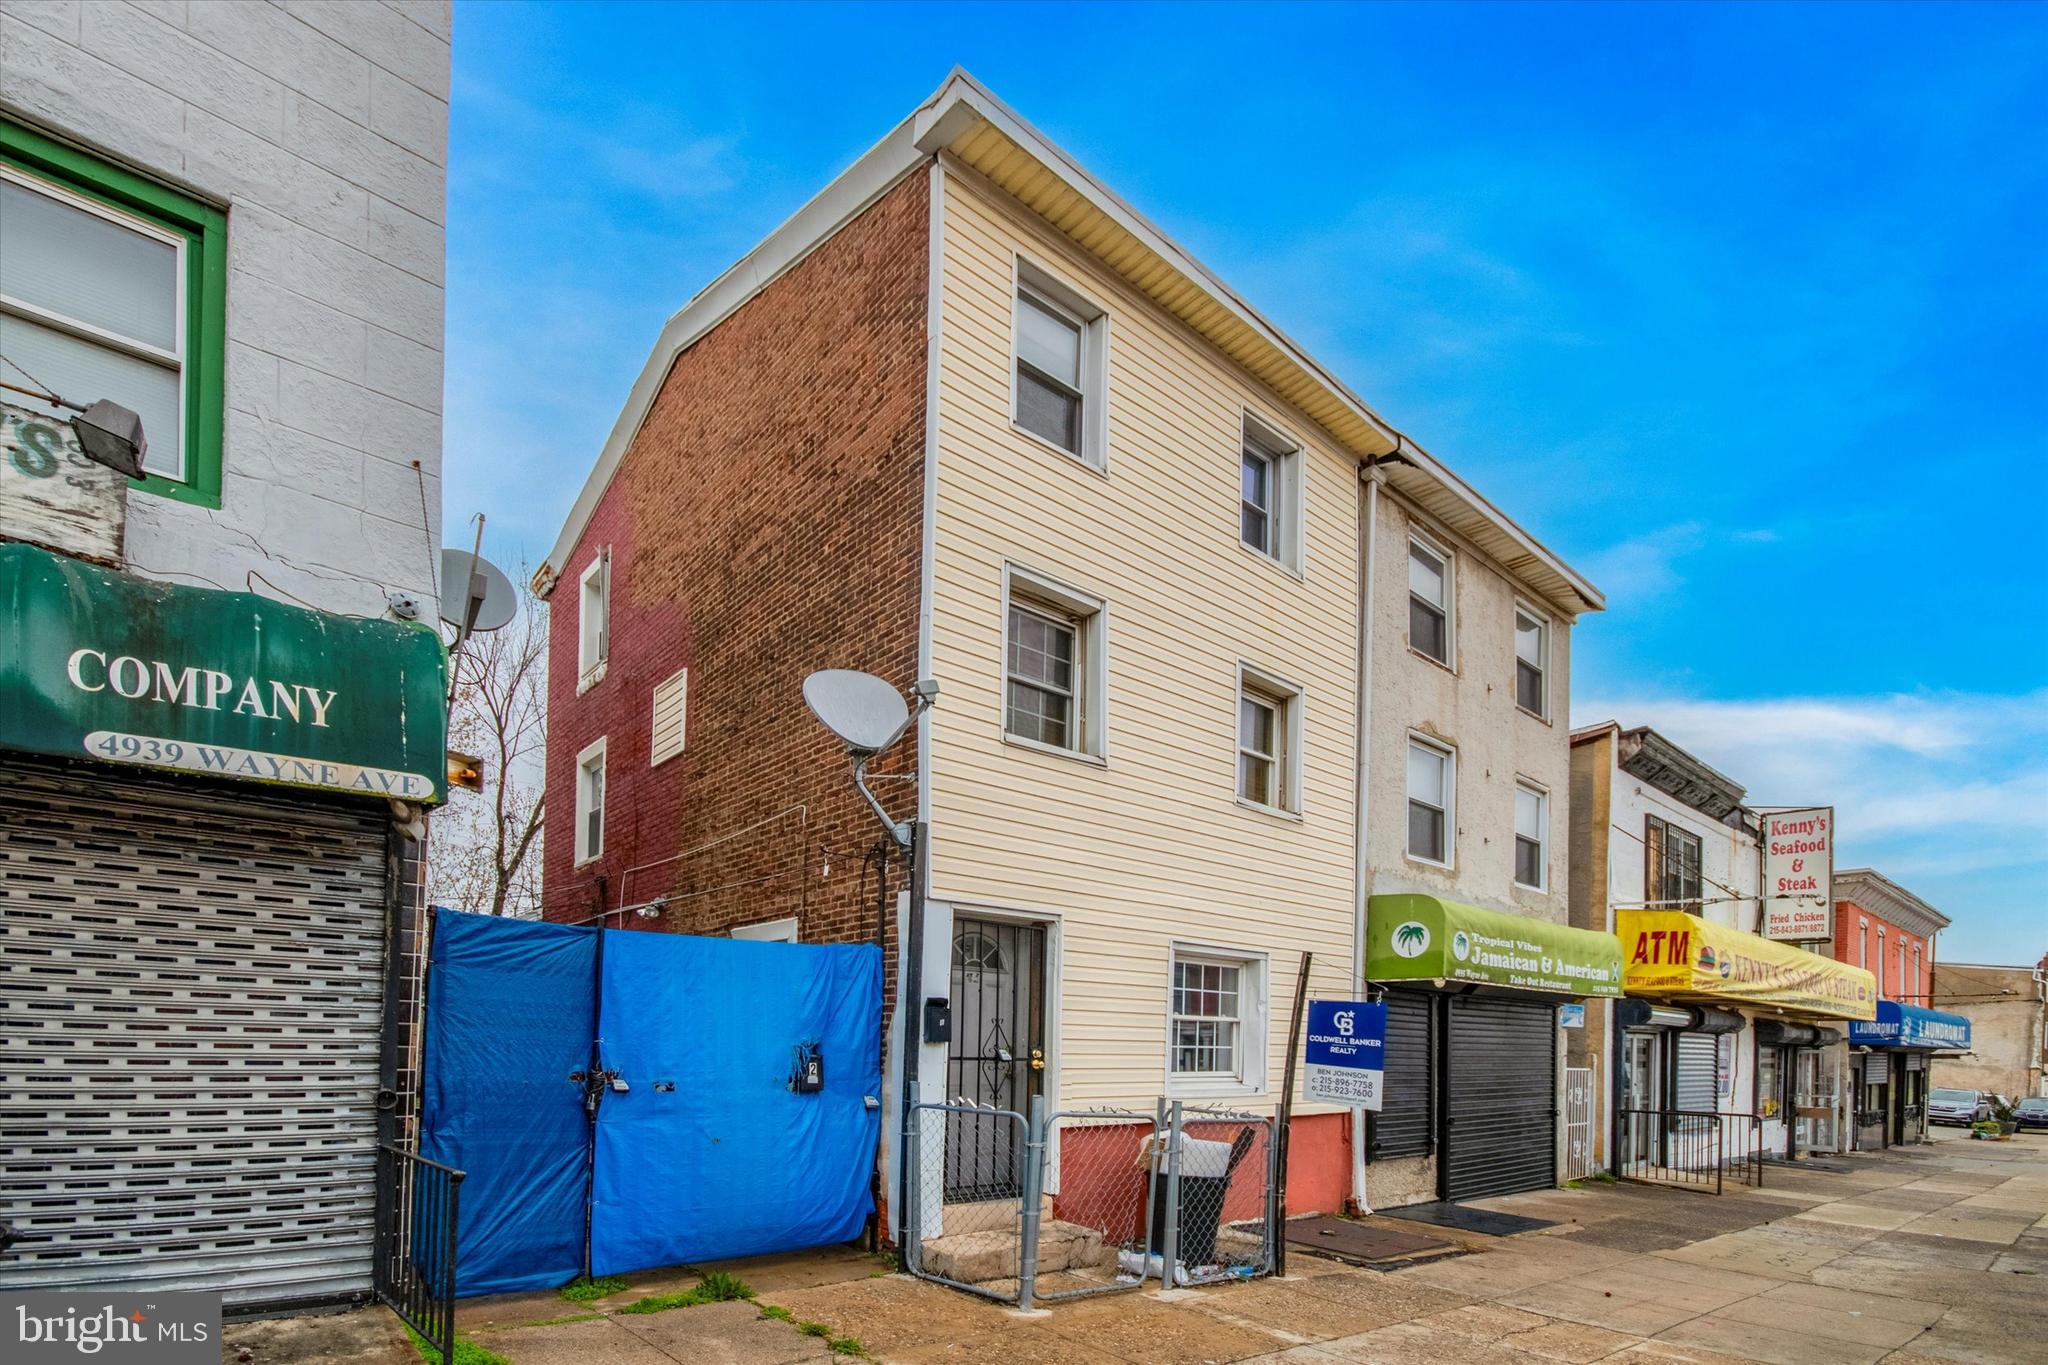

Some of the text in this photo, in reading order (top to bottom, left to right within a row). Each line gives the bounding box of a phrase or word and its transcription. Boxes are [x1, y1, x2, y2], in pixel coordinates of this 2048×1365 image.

[68, 649, 337, 727] COMPANY
[98, 734, 421, 796] 4939 WAYNE AVE
[1771, 816, 1826, 836] Kenny's
[1771, 838, 1826, 855] Seafood
[1792, 859, 1804, 873] &
[1778, 876, 1817, 891] Steak
[1770, 912, 1825, 923] Fried Chicken
[1472, 932, 1542, 953] Tropical Vibes
[1631, 931, 1690, 965] ATM
[1471, 946, 1609, 981] Jamaican & American
[1509, 974, 1572, 990] Take Out Restaurant
[1855, 1022, 1900, 1035] LAUNDROMAT
[1919, 1020, 1966, 1041] LAUNDROMAT
[1309, 1035, 1381, 1047] COLDWELL BANKER
[1330, 1046, 1357, 1055] REALTY
[810, 1063, 817, 1075] 2
[1333, 1070, 1368, 1079] JOHNSON
[1320, 1076, 1373, 1089] 215-896-7758
[1319, 1085, 1373, 1098] 215-923-7600
